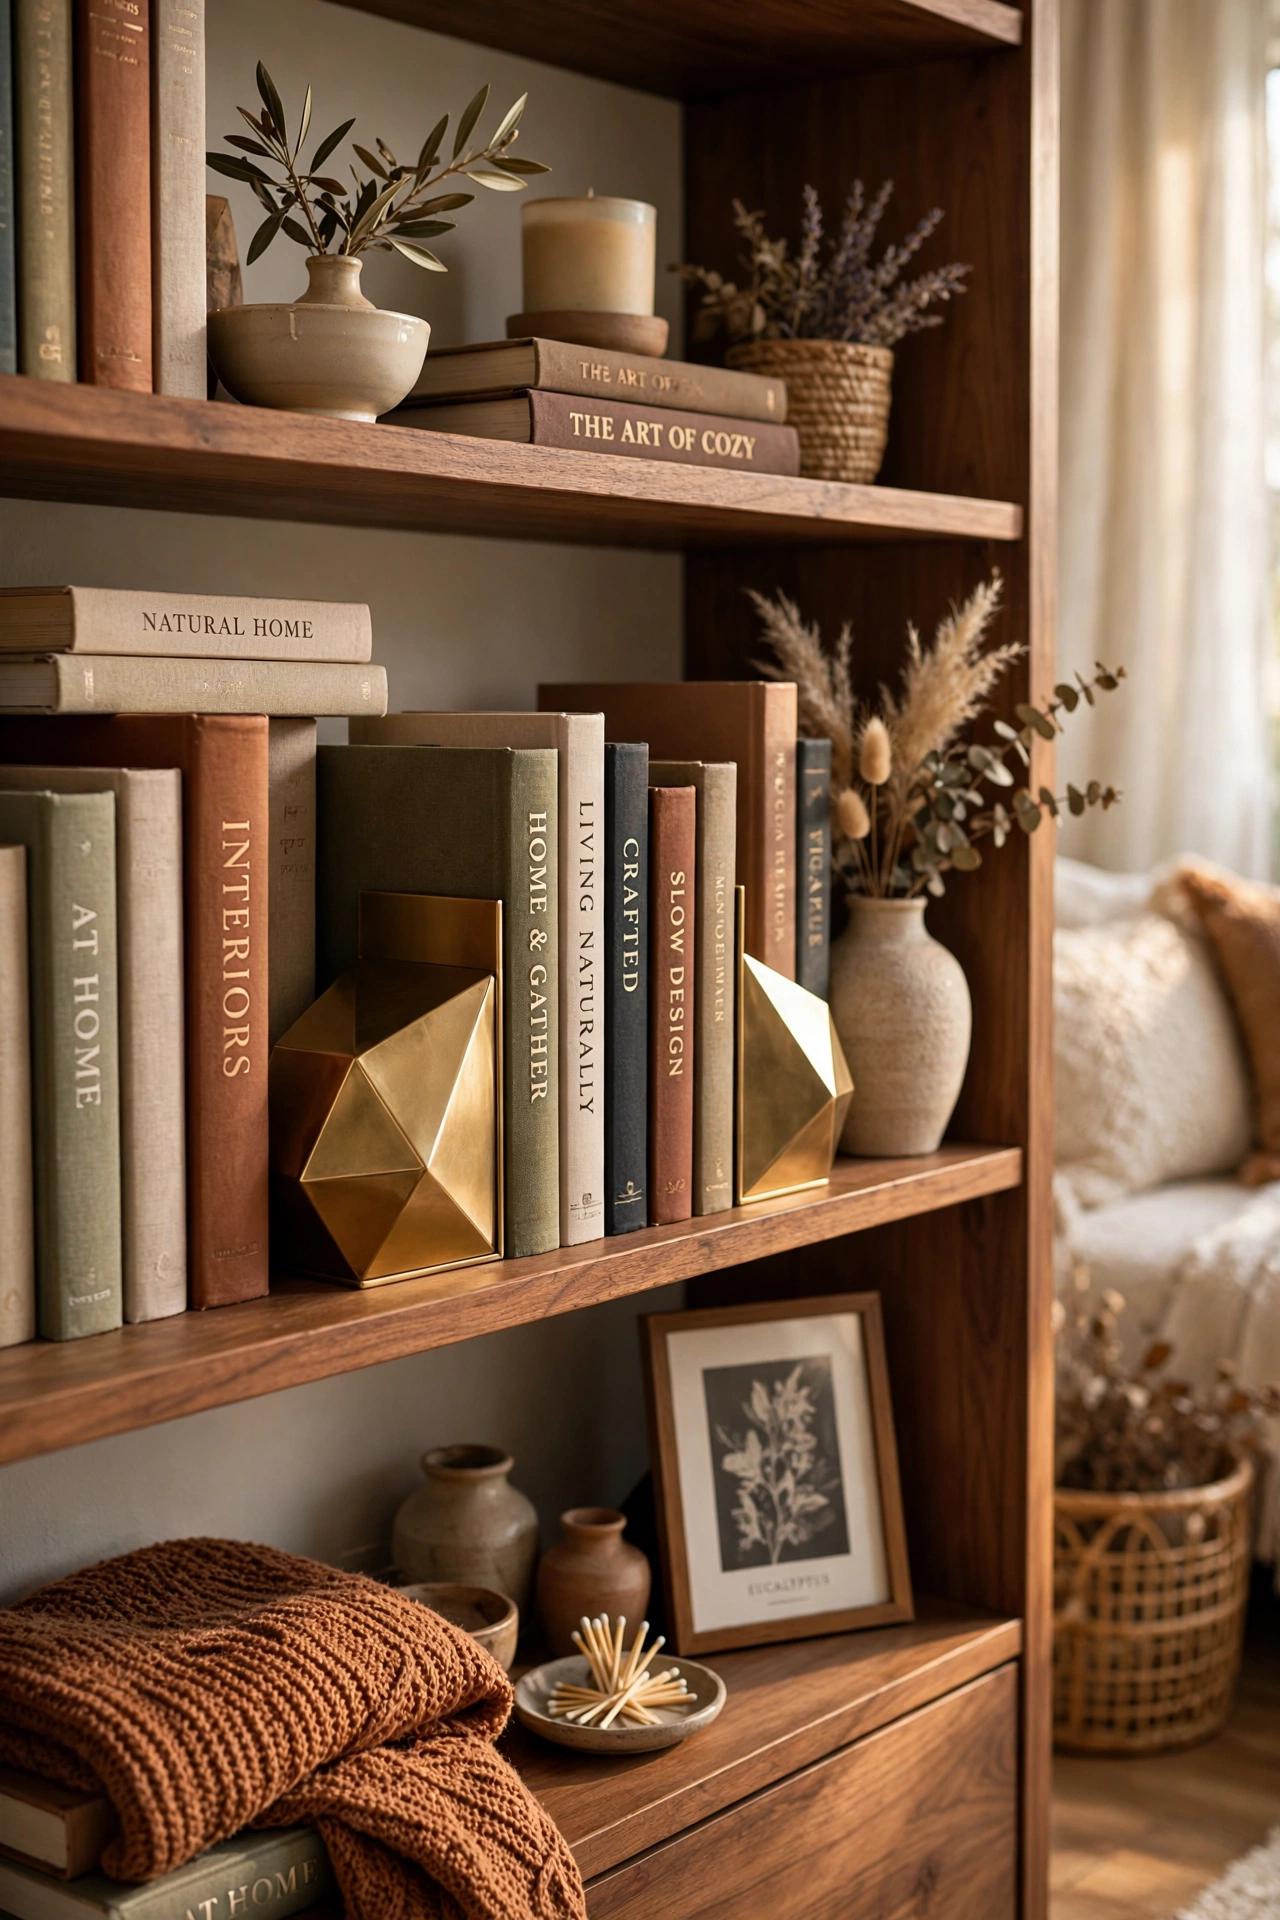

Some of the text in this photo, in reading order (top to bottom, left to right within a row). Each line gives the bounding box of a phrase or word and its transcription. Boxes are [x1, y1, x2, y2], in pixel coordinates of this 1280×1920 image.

[570, 412, 756, 460] THE ART OF COZY
[579, 361, 611, 383] THE
[617, 368, 647, 388] ART
[142, 612, 313, 639] NATURAL HOME
[222, 820, 251, 1078] INTERIORS
[529, 811, 548, 1104] HOME & GATHER
[579, 801, 595, 1115] LIVING NATURALLY
[623, 838, 639, 993] CRAFTED
[668, 871, 686, 1077] SLOW DESIGN
[72, 903, 102, 1109] AT HOME
[227, 1857, 318, 1919] HOME
